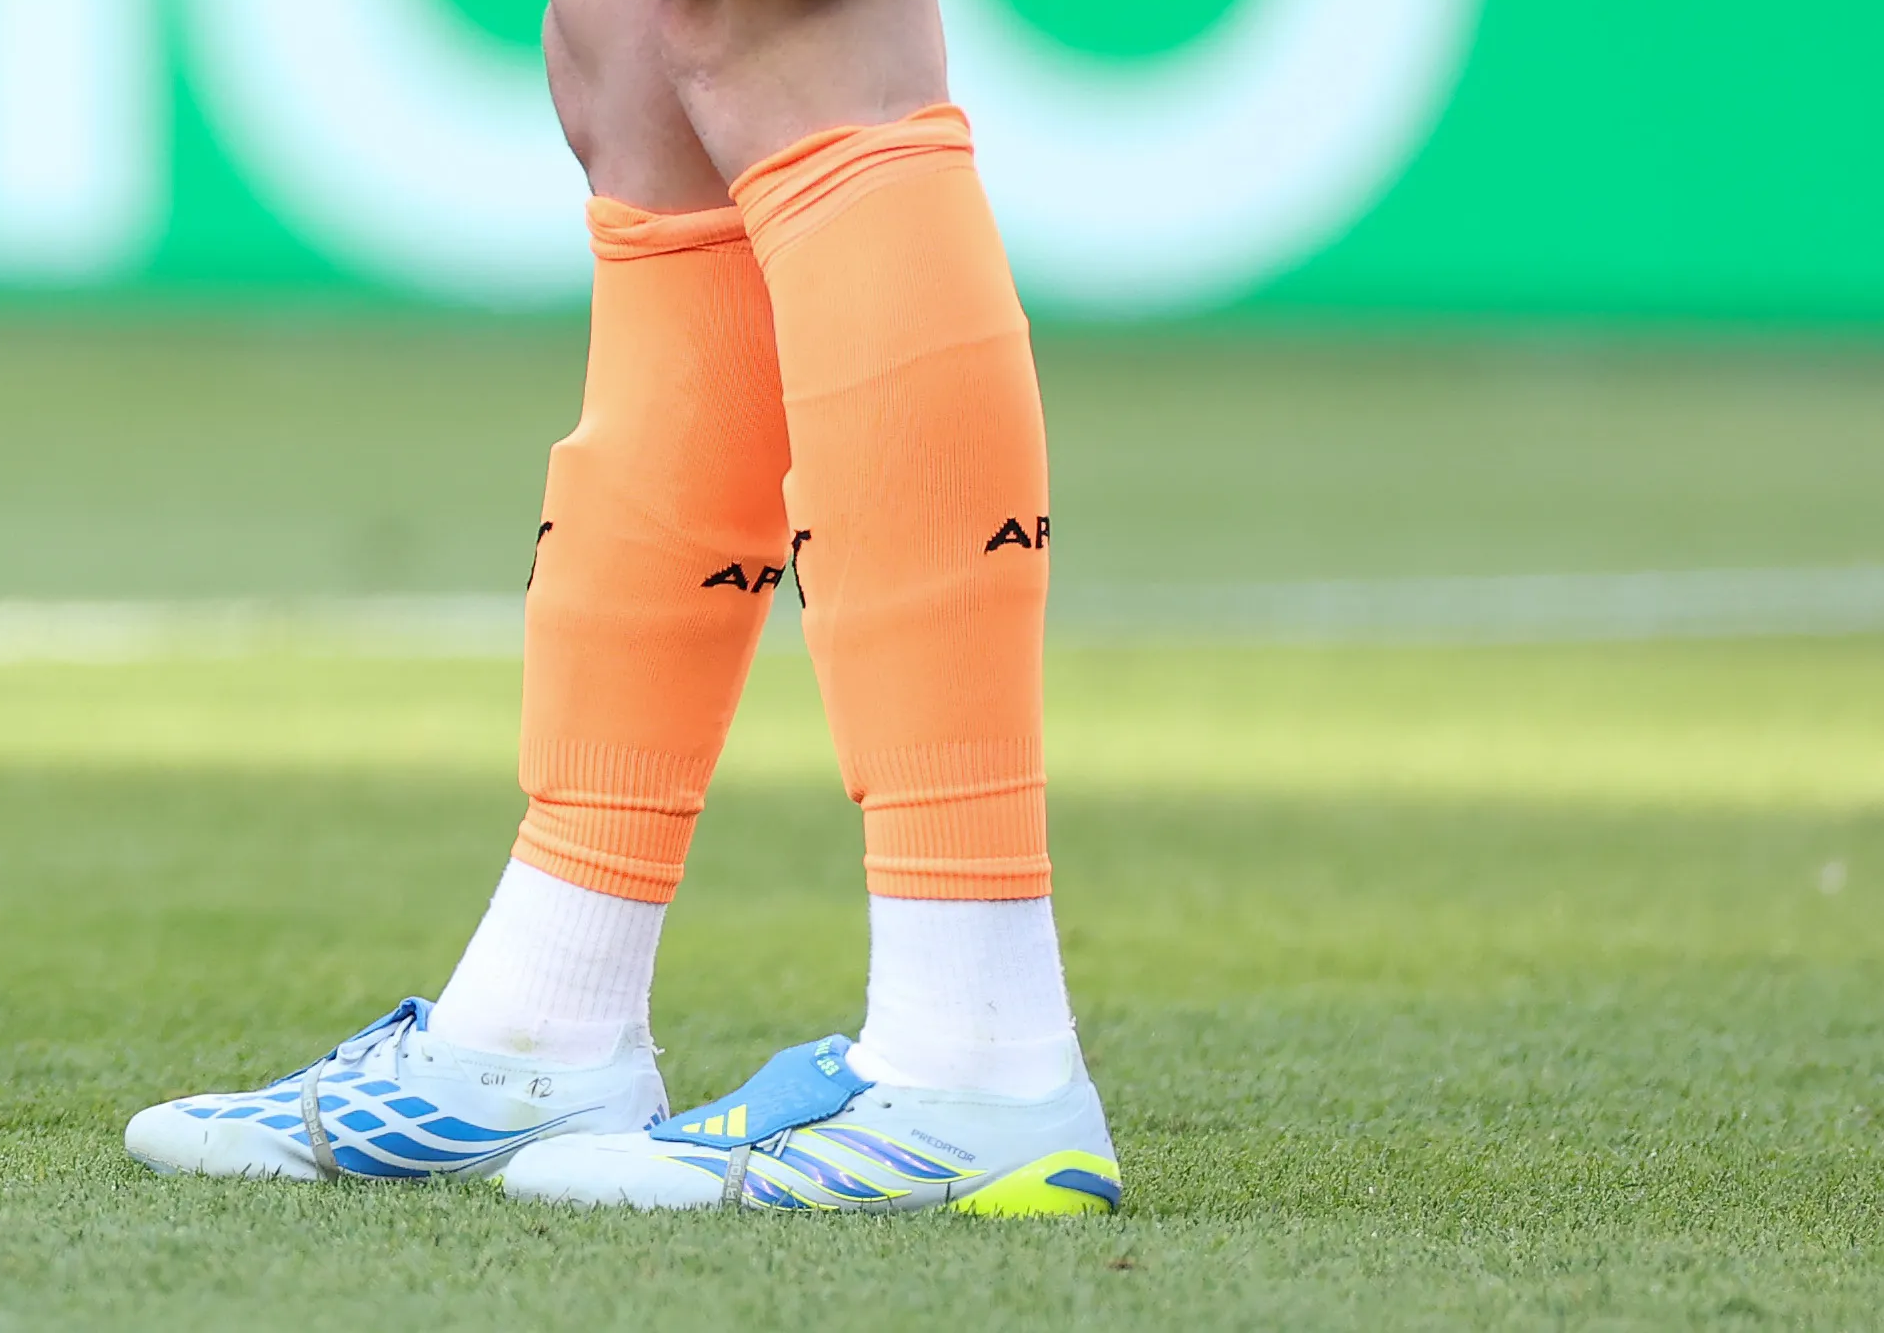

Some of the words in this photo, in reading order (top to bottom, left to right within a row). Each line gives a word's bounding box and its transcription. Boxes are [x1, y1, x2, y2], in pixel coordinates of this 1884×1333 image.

[983, 516, 1050, 556] AR
[700, 561, 786, 593] AR
[528, 1076, 554, 1099] 12
[911, 1129, 976, 1163] PREDATOR
